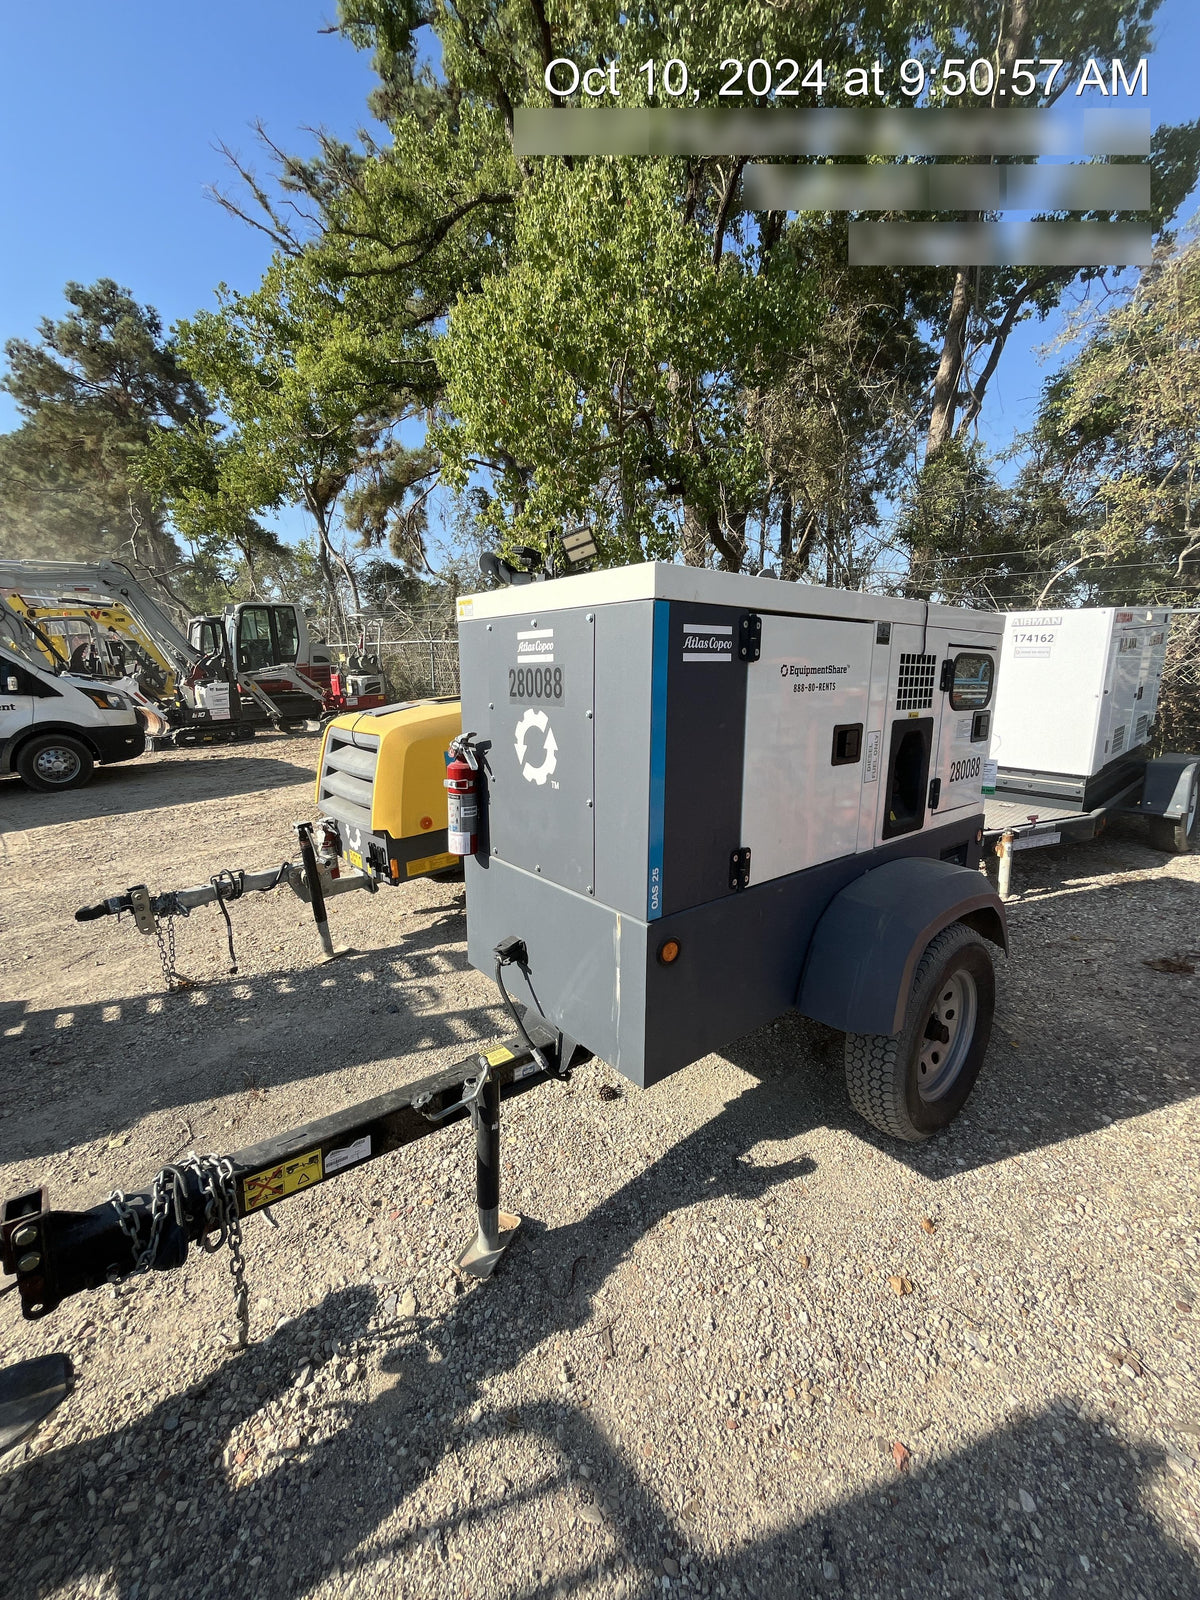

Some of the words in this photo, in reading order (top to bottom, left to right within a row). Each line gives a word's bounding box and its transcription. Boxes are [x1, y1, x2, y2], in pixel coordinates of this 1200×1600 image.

[1012, 617, 1062, 627] AIRMAN
[517, 641, 535, 653] Atlas
[535, 639, 554, 652] Copco
[683, 635, 709, 650] Atlas
[709, 636, 733, 651] Copco
[1013, 633, 1055, 644] 174162
[509, 667, 562, 698] 280088
[793, 682, 836, 693] 888-80-RENTS
[949, 757, 981, 782] 280088
[651, 867, 659, 882] 25
[651, 885, 659, 909] QAS
